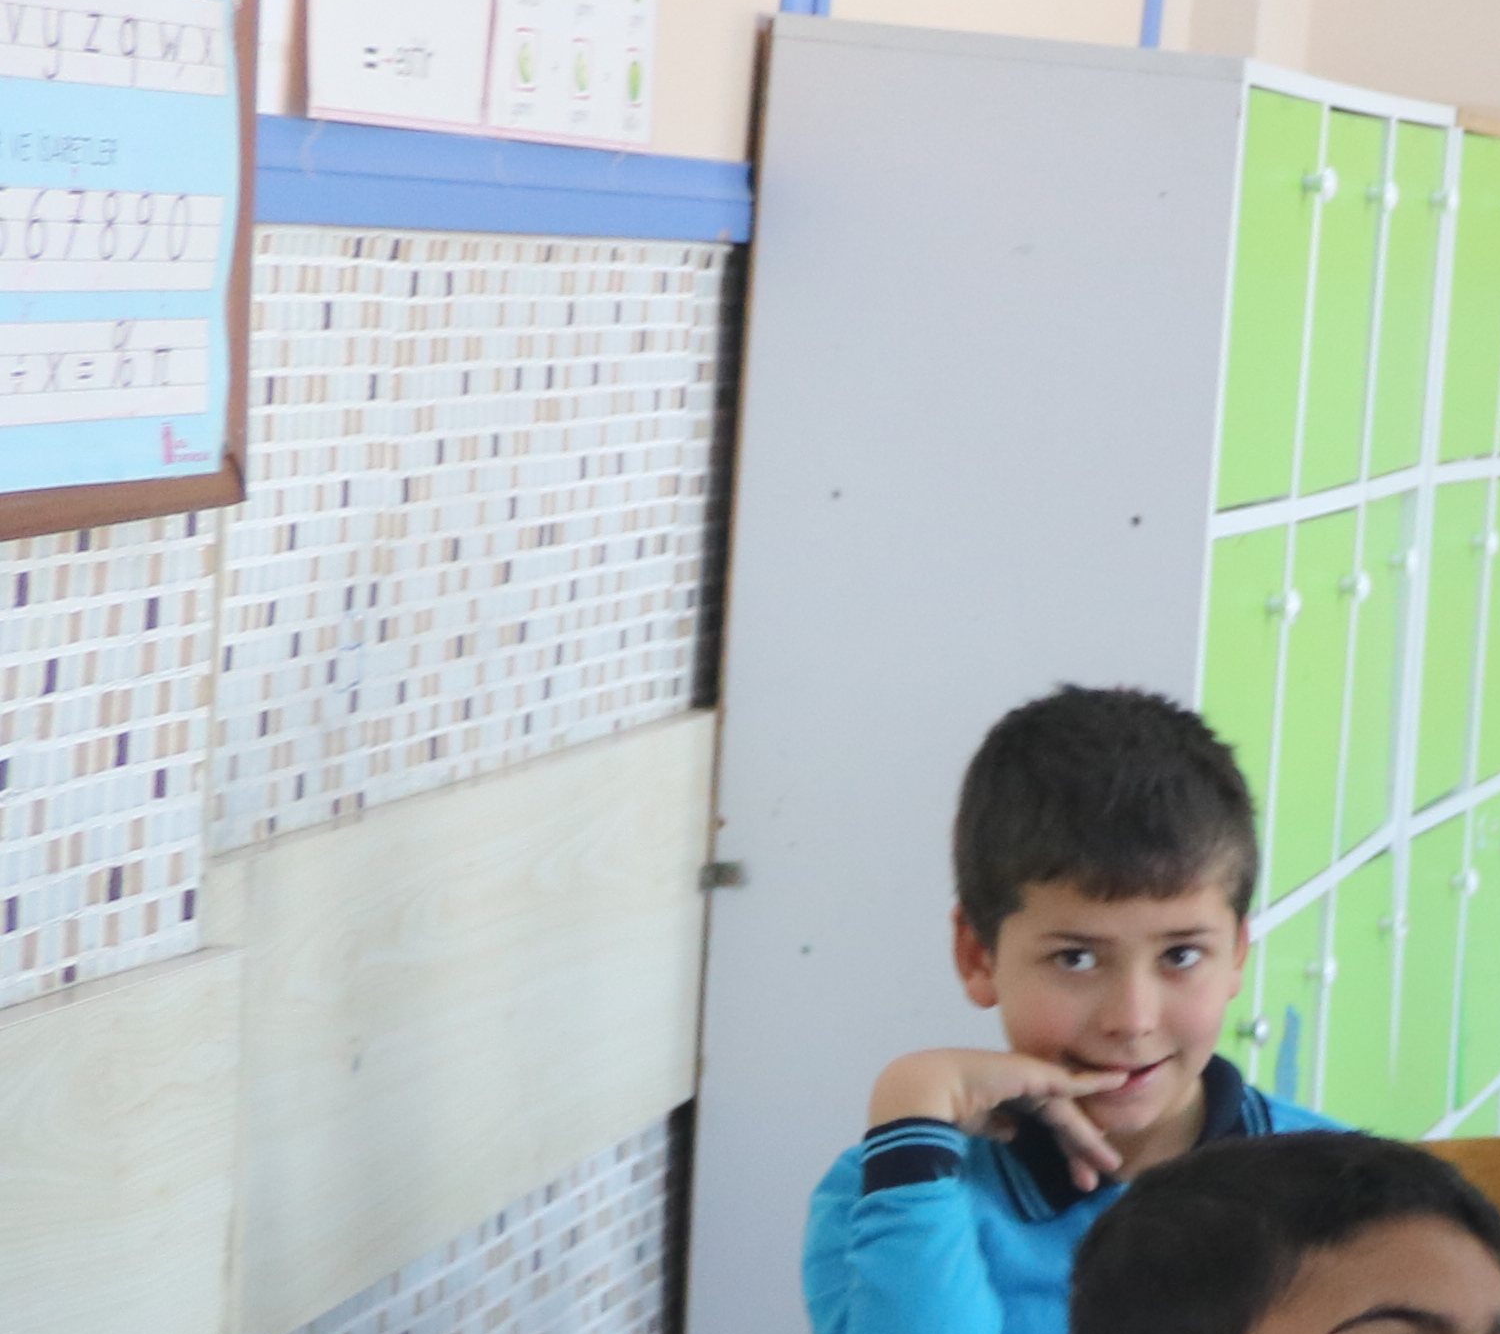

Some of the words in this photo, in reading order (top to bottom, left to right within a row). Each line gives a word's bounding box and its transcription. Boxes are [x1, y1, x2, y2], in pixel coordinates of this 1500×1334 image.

[83, 12, 105, 54] z
[24, 188, 50, 260] 6
[63, 188, 87, 259] 7
[99, 191, 120, 261] 8
[128, 191, 155, 261] 9
[166, 193, 191, 261] 0
